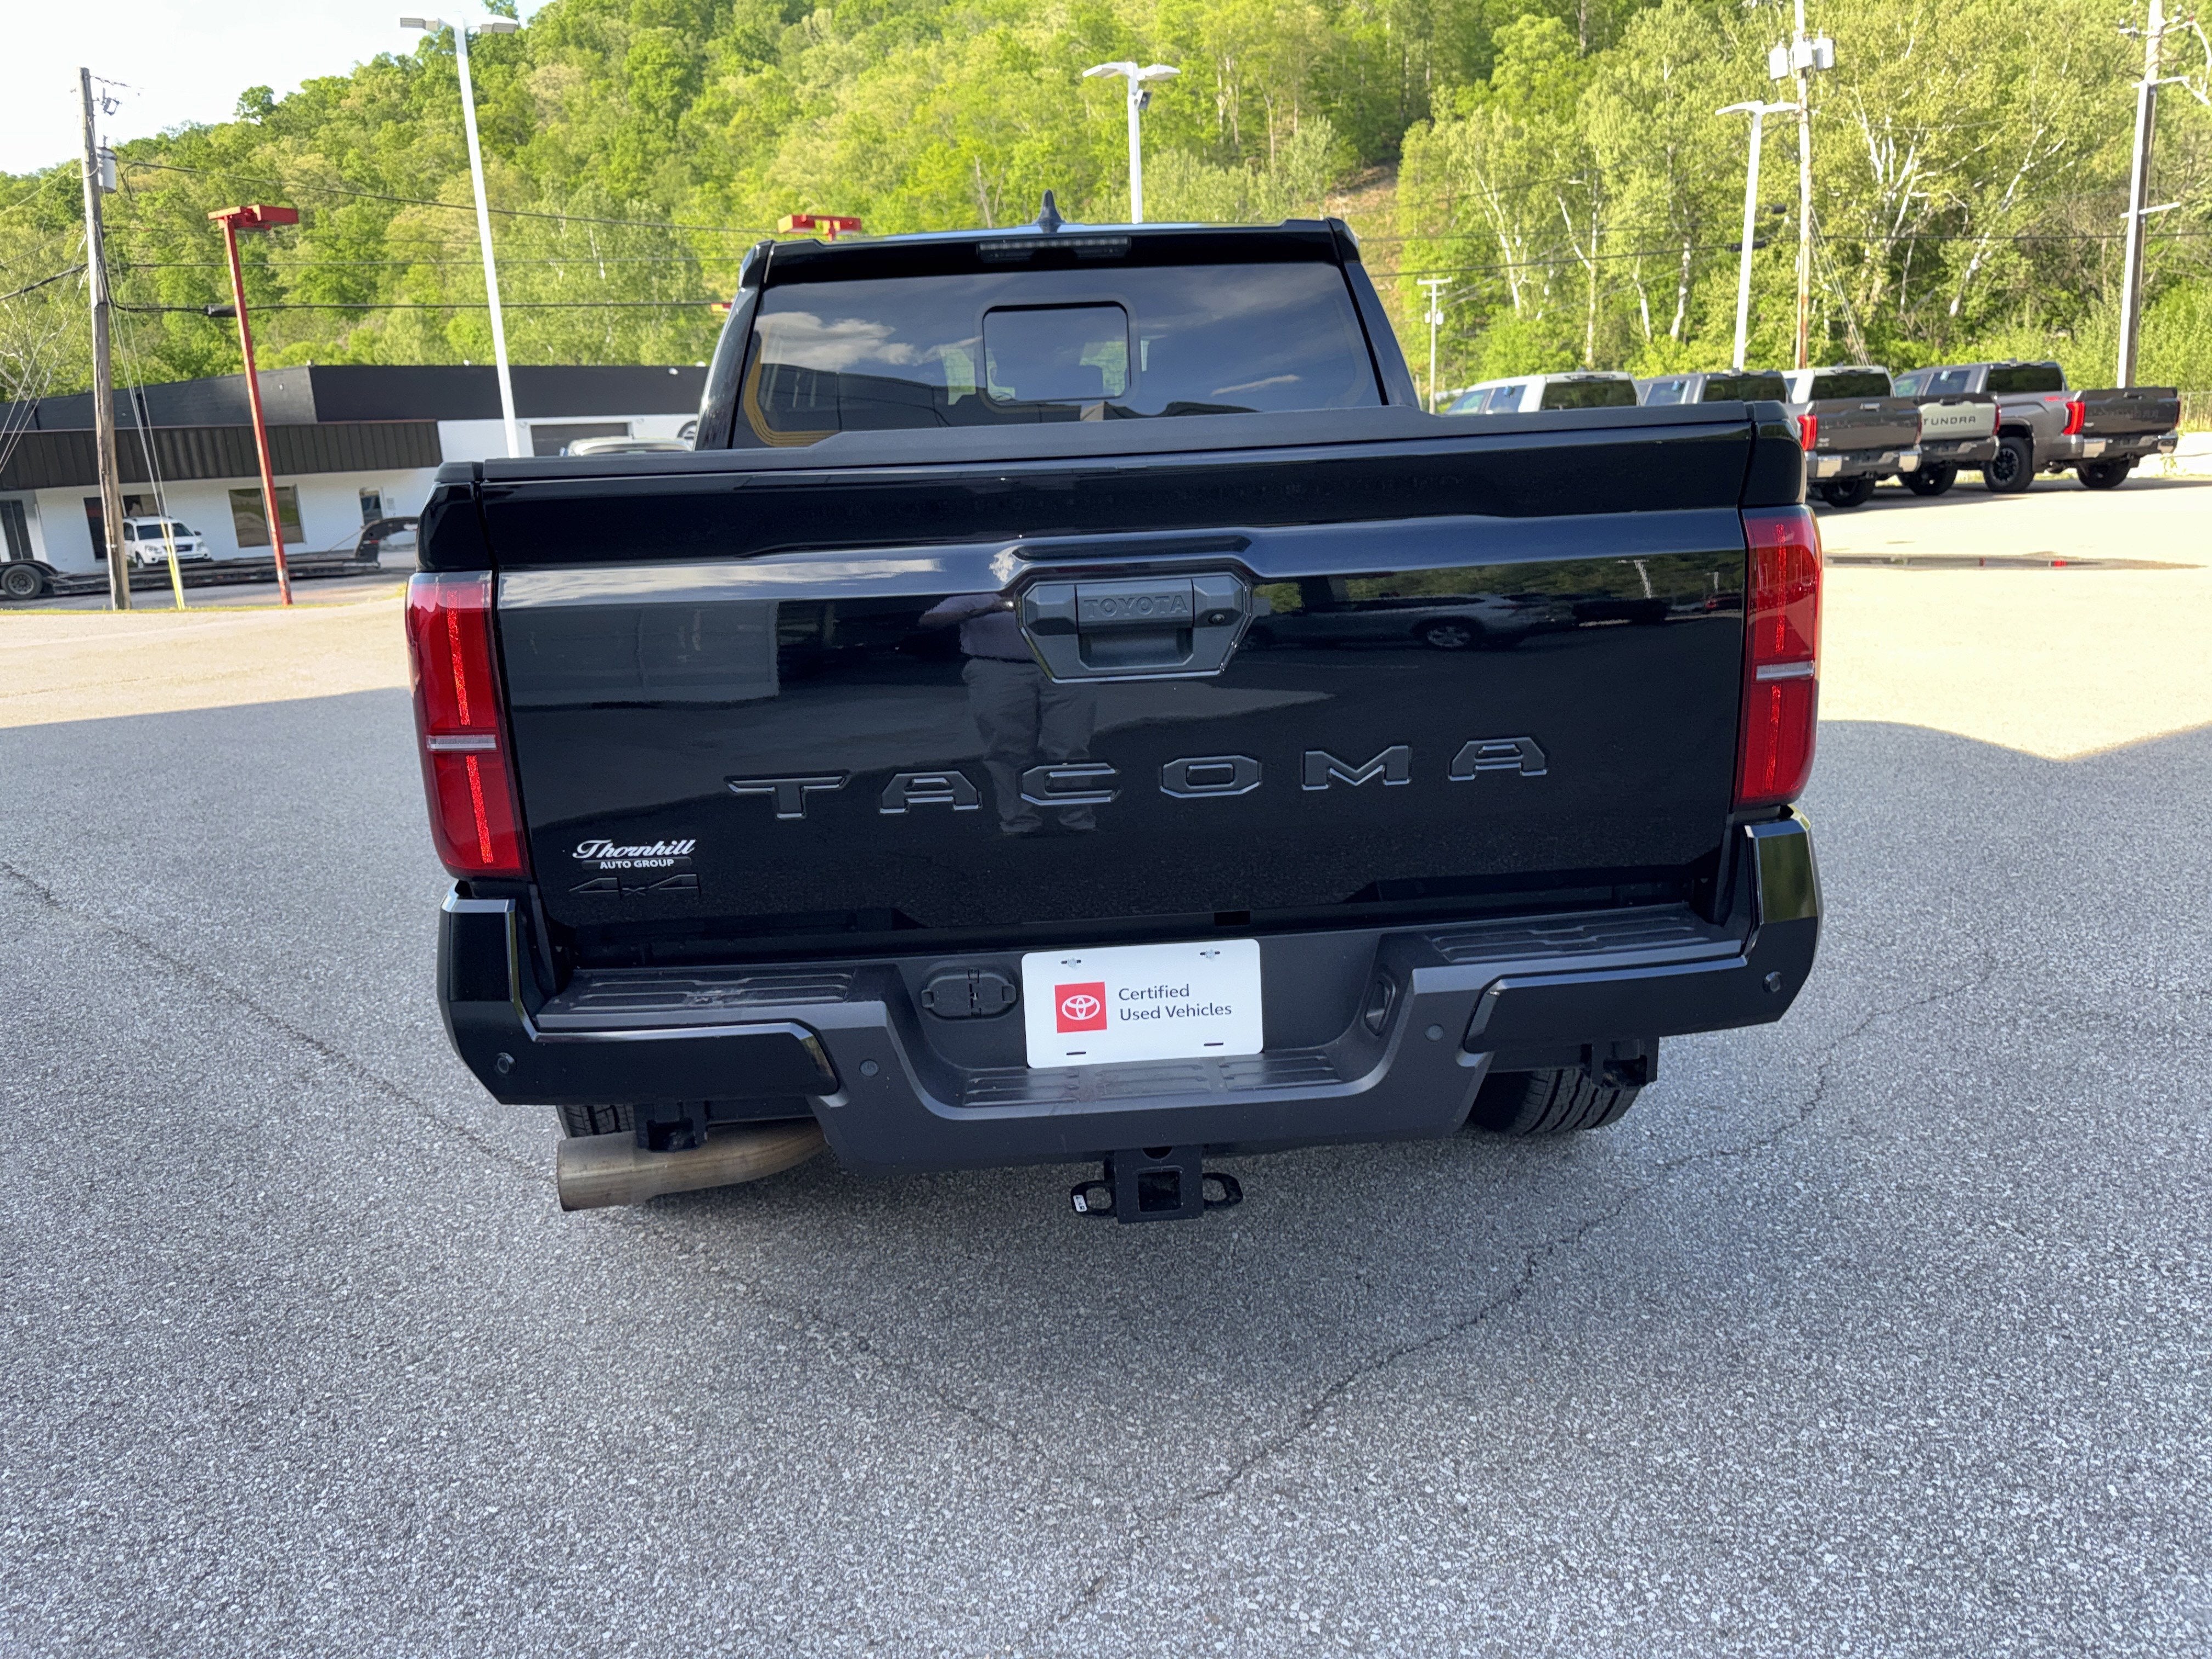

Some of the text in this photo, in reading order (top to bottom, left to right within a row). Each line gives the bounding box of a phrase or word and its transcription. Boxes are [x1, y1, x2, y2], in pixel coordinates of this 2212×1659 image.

[1923, 416, 1976, 426] TUNDRA
[1083, 595, 1189, 619] TOYOTA
[724, 736, 1548, 820] TACOMA
[572, 839, 697, 859] Thornhill
[600, 859, 675, 870] AUTO GROUP
[1118, 983, 1190, 1001] Certified
[1120, 1002, 1233, 1021] Used Vehicles
